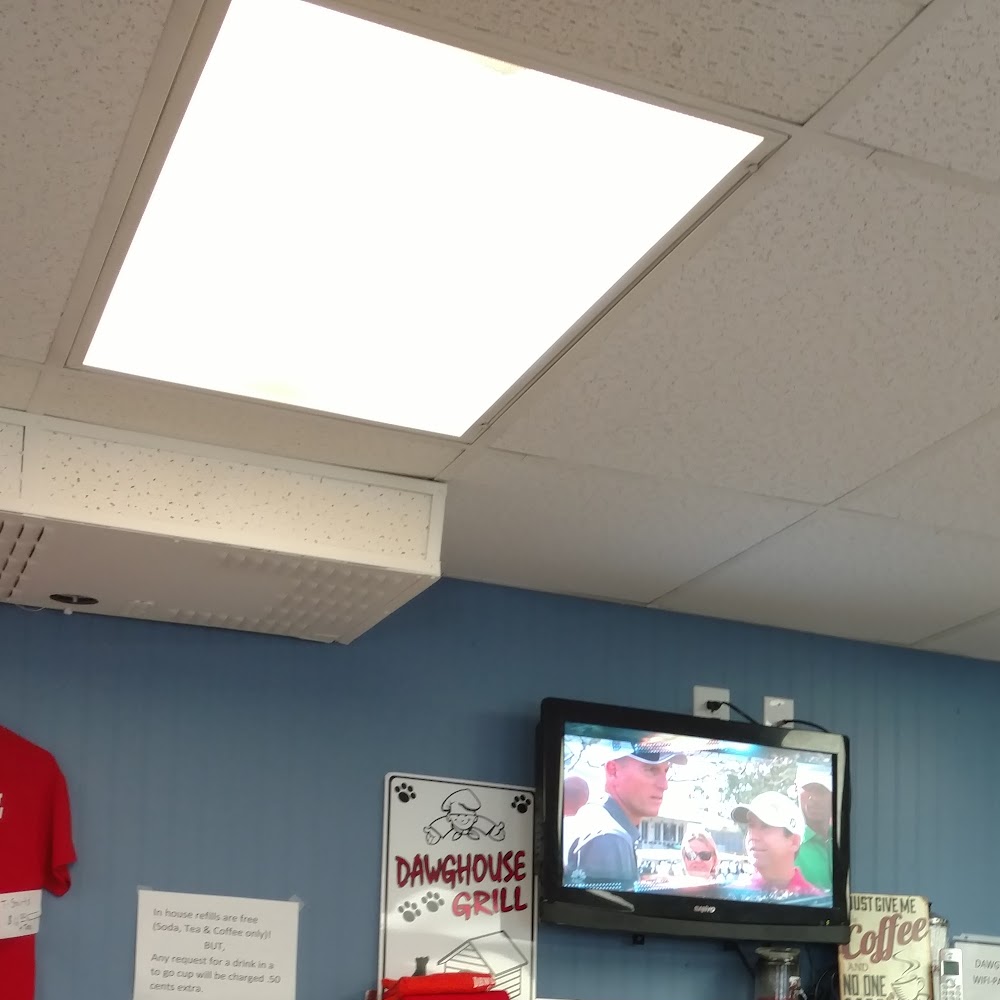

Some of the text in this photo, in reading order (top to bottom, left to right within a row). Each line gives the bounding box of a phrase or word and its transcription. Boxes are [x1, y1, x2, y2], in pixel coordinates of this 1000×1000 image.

[395, 850, 527, 889] DAWGHOUSE
[451, 886, 528, 921] GRILL
[875, 897, 898, 912] GIVE
[901, 897, 916, 913] ME
[153, 908, 258, 924] In house refills are free
[184, 924, 200, 934] Tea
[203, 926, 211, 934] &
[213, 926, 242, 937] Coffee
[840, 913, 930, 963] Coffee
[204, 941, 226, 951] BUT,
[151, 953, 169, 964] Any
[172, 955, 207, 967] request
[209, 956, 223, 966] for
[233, 959, 256, 969] drink
[258, 960, 267, 969] in
[975, 959, 1000, 970] DAWG
[150, 968, 160, 976] to
[163, 970, 175, 979] go
[176, 971, 194, 981] cup
[196, 971, 212, 979] will
[214, 972, 226, 981] be
[228, 973, 264, 984] charged
[150, 982, 175, 991] cents
[843, 974, 887, 996] NO ONE
